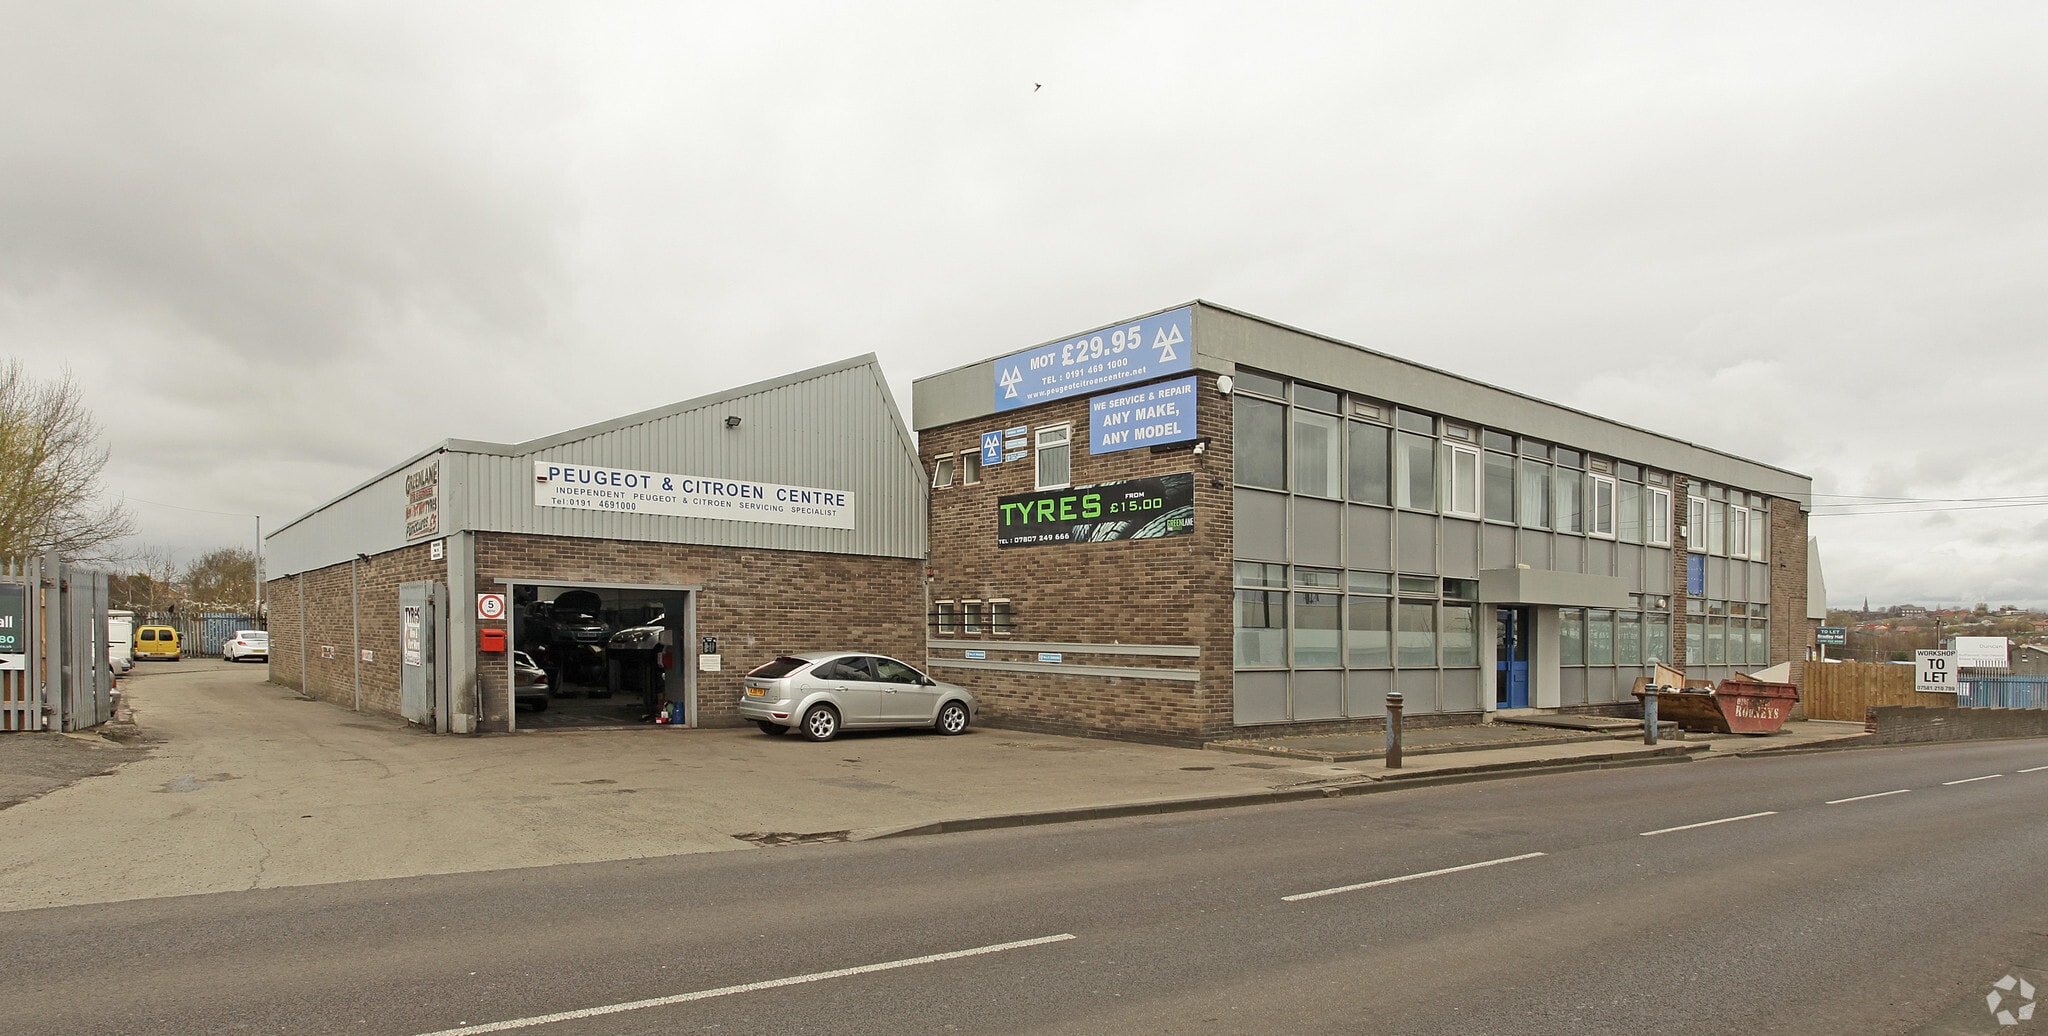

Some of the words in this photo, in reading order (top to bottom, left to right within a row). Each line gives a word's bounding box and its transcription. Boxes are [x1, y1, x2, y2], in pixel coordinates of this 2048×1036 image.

[1030, 353, 1055, 371] MOT
[1062, 325, 1142, 367] £29.95
[1027, 366, 1147, 400] www.peugeotcitroencentre.net
[1042, 375, 1057, 385] TEL
[1066, 368, 1084, 380] 0191
[1088, 363, 1104, 375] 469
[1107, 357, 1128, 370] 1000
[1094, 401, 1107, 411] WE
[1109, 394, 1145, 409] SERVICE
[1148, 391, 1155, 400] &
[1158, 384, 1191, 399] REPAIR
[1103, 411, 1131, 427] ANY
[1135, 402, 1180, 421] MAKE,
[1102, 430, 1129, 446] ANY
[1134, 422, 1182, 441] MODEL
[549, 466, 651, 490] PEUGEOT
[661, 477, 673, 491] &
[682, 480, 763, 500] CITROEN
[776, 488, 845, 507] CENTRE
[1125, 491, 1145, 499] FROM
[551, 497, 592, 508] Tel:0191
[599, 501, 636, 511] 4691000
[556, 487, 625, 499] INDEPENDENT
[633, 493, 677, 503] PEUGEOT
[693, 498, 732, 508] CITROEN
[739, 502, 784, 513] SERVICING
[791, 507, 837, 517] SPECIALIST
[1000, 493, 1101, 526] TYRES
[1110, 497, 1162, 513] £15.00
[1014, 535, 1037, 543] 07807
[1039, 534, 1053, 542] 249
[488, 600, 494, 609] 5
[1927, 658, 1945, 670] TO
[1924, 671, 1948, 682] LET
